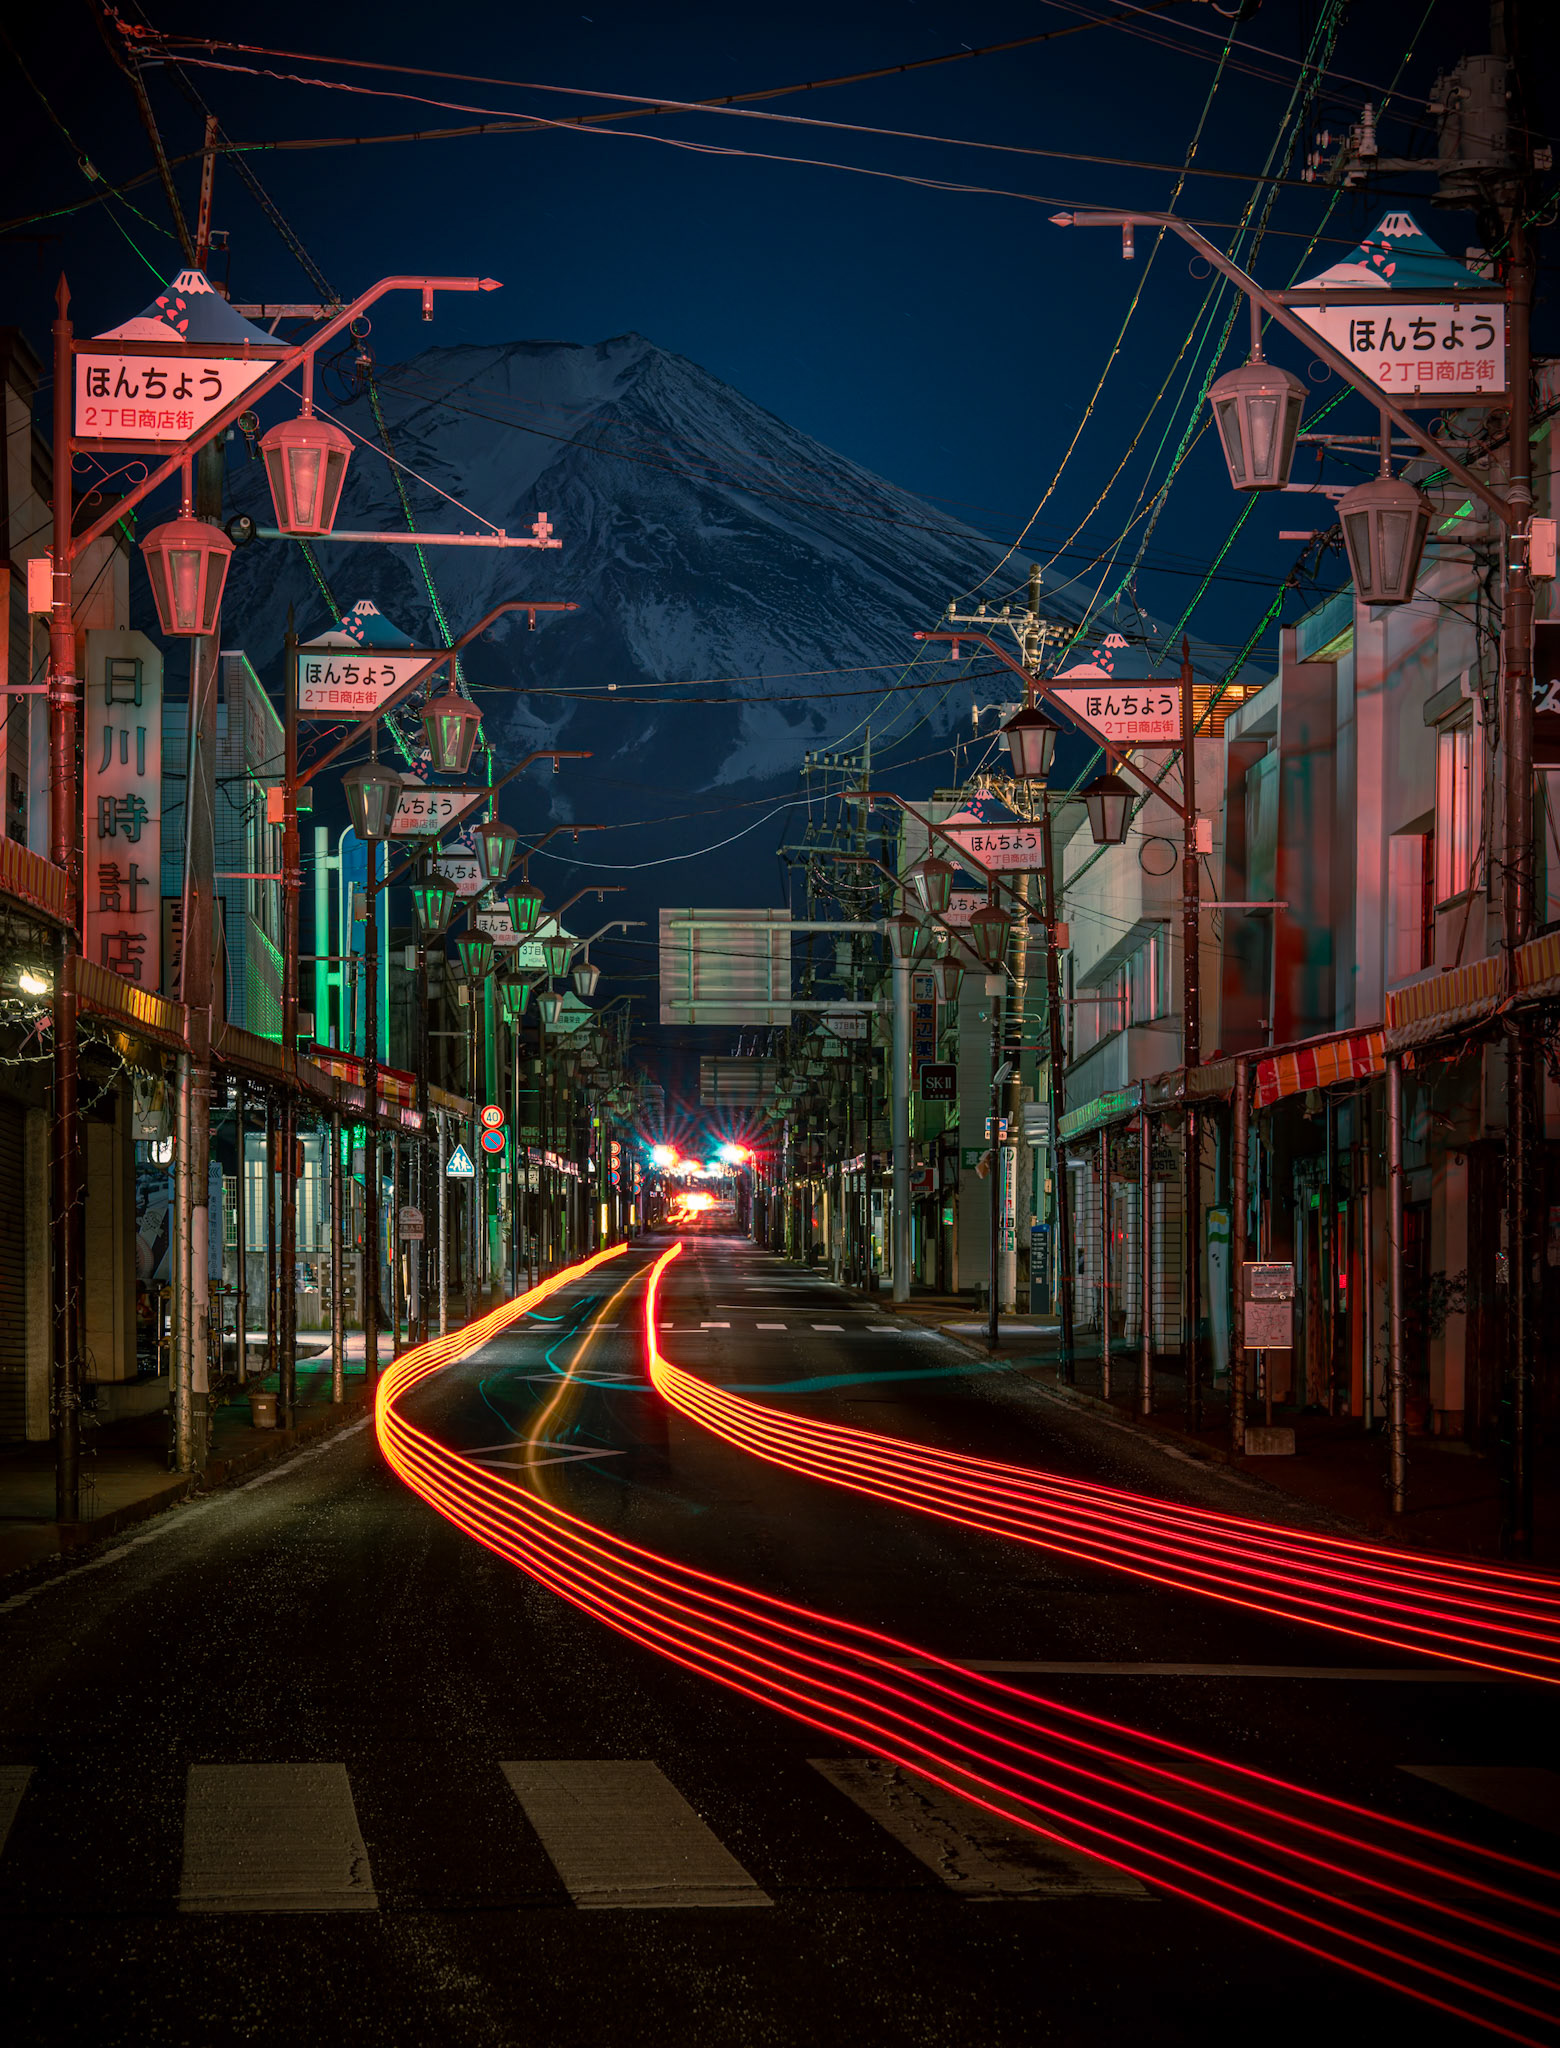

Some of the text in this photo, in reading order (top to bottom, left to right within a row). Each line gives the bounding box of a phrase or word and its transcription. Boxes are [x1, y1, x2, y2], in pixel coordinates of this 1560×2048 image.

[1349, 315, 1496, 352] ほんちょう
[1379, 360, 1496, 382] 2丁目商店街
[86, 366, 222, 401] ほんちょう
[85, 407, 194, 430] 2丁目商店街
[306, 663, 396, 687] ほんちょう
[305, 689, 378, 704] 2丁目商店街
[1086, 694, 1173, 717] ほんちょう
[1104, 720, 1174, 734] 2丁目商店街
[397, 797, 452, 816] んちょう
[97, 657, 149, 981] 日川時計店
[393, 818, 438, 829] 丁目商店街
[971, 833, 1037, 852] ほんちょう
[985, 853, 1038, 865] 2丁目商店街
[434, 865, 477, 879] んちょ
[480, 920, 514, 932] ほんち
[522, 945, 545, 956] 3丁目
[486, 1111, 499, 1123] 40
